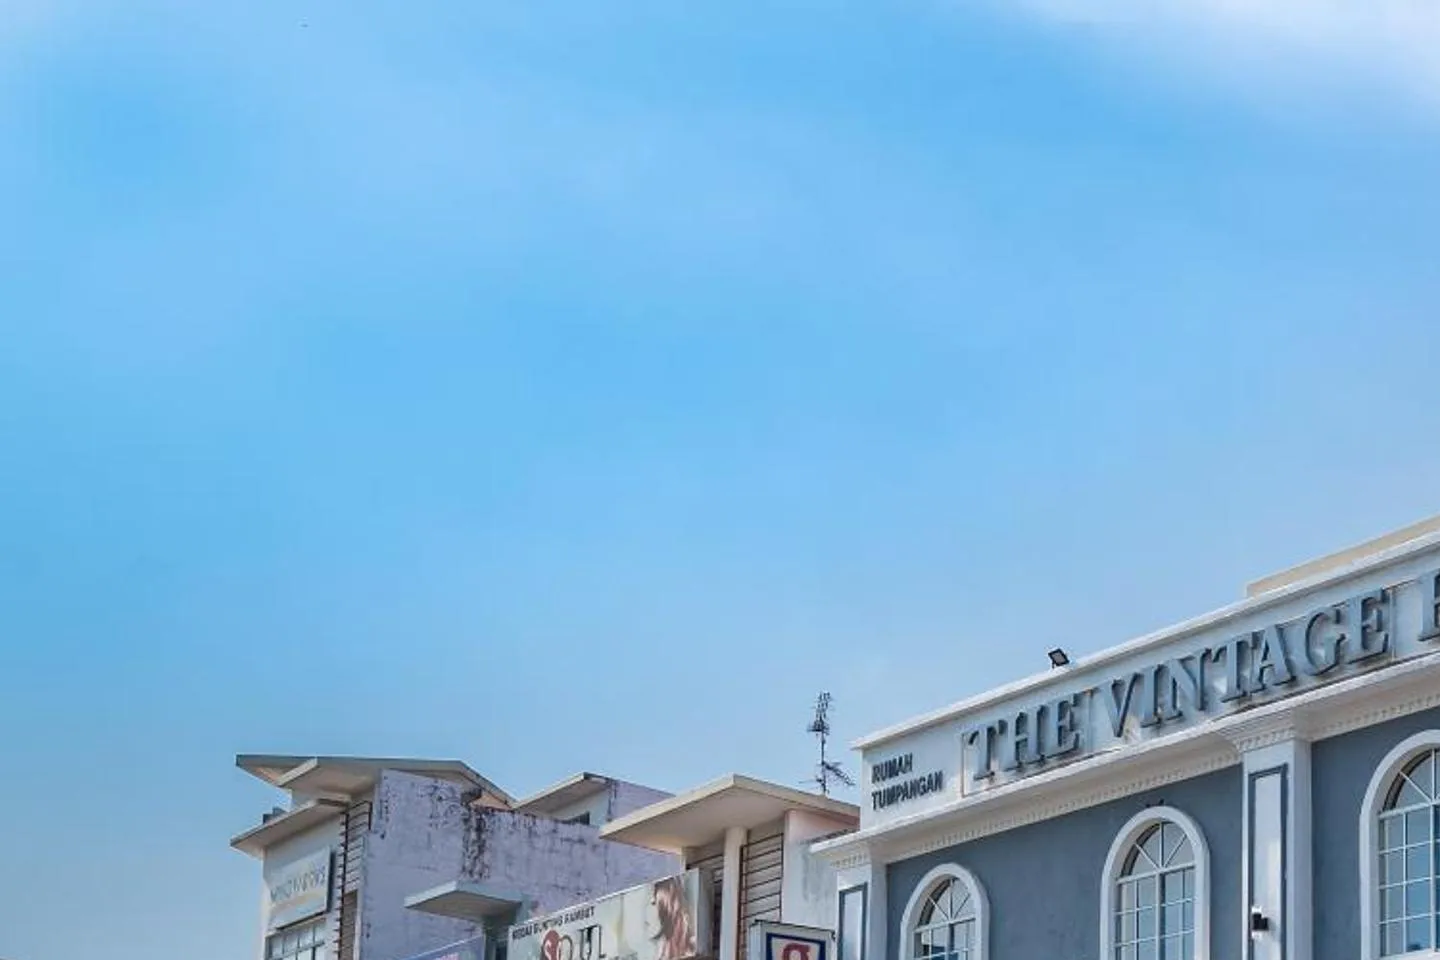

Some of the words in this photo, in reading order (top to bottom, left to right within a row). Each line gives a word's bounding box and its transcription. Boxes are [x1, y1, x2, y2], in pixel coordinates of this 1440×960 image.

[967, 699, 1081, 781] THE
[1099, 587, 1391, 738] VINTAGE
[871, 753, 913, 784] RUMAH
[871, 770, 944, 811] TUMPANGAN
